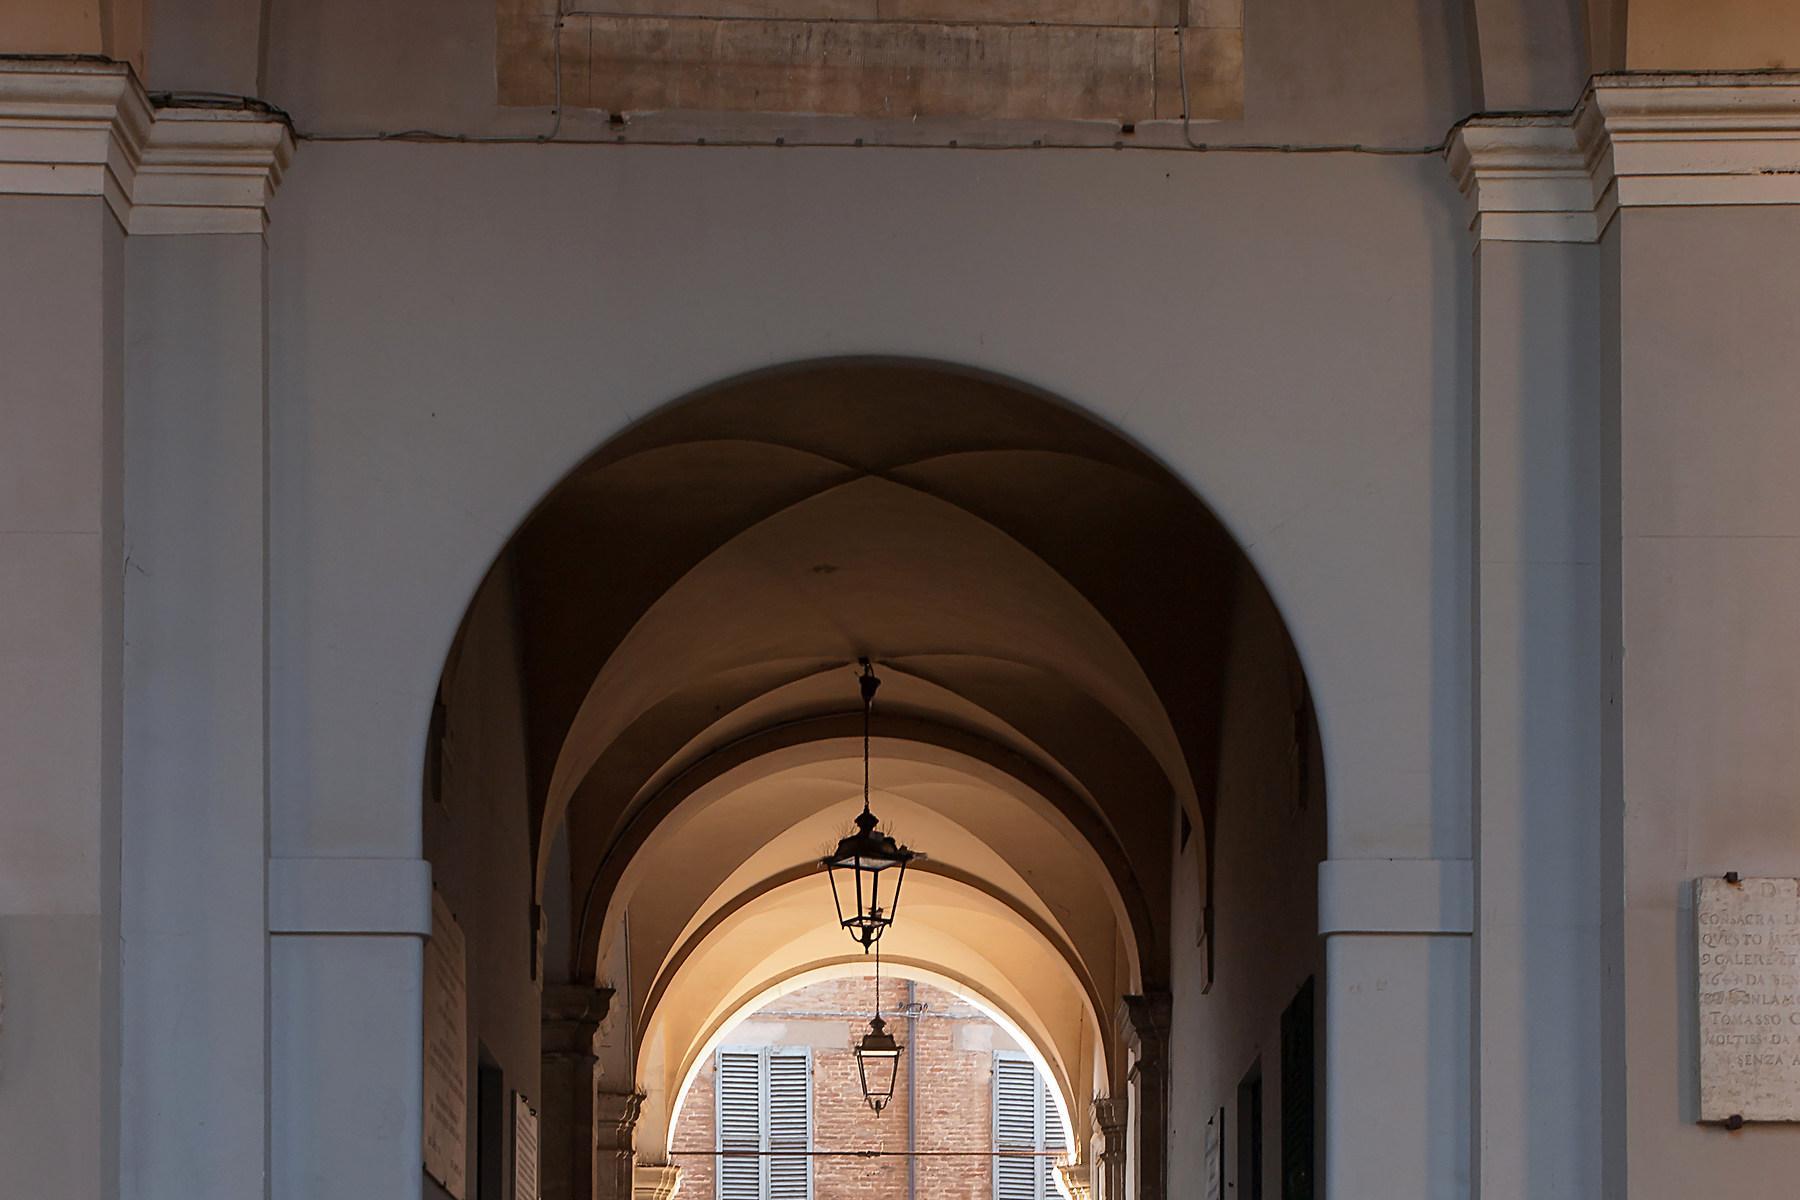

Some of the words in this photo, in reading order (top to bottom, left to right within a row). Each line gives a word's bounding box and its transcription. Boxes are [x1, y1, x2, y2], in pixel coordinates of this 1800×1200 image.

[1701, 953, 1711, 966] 9
[1745, 973, 1766, 986] DA
[1708, 1011, 1781, 1026] TOMASSO
[1769, 1033, 1791, 1046] DA
[1736, 1053, 1784, 1068] SENZA
